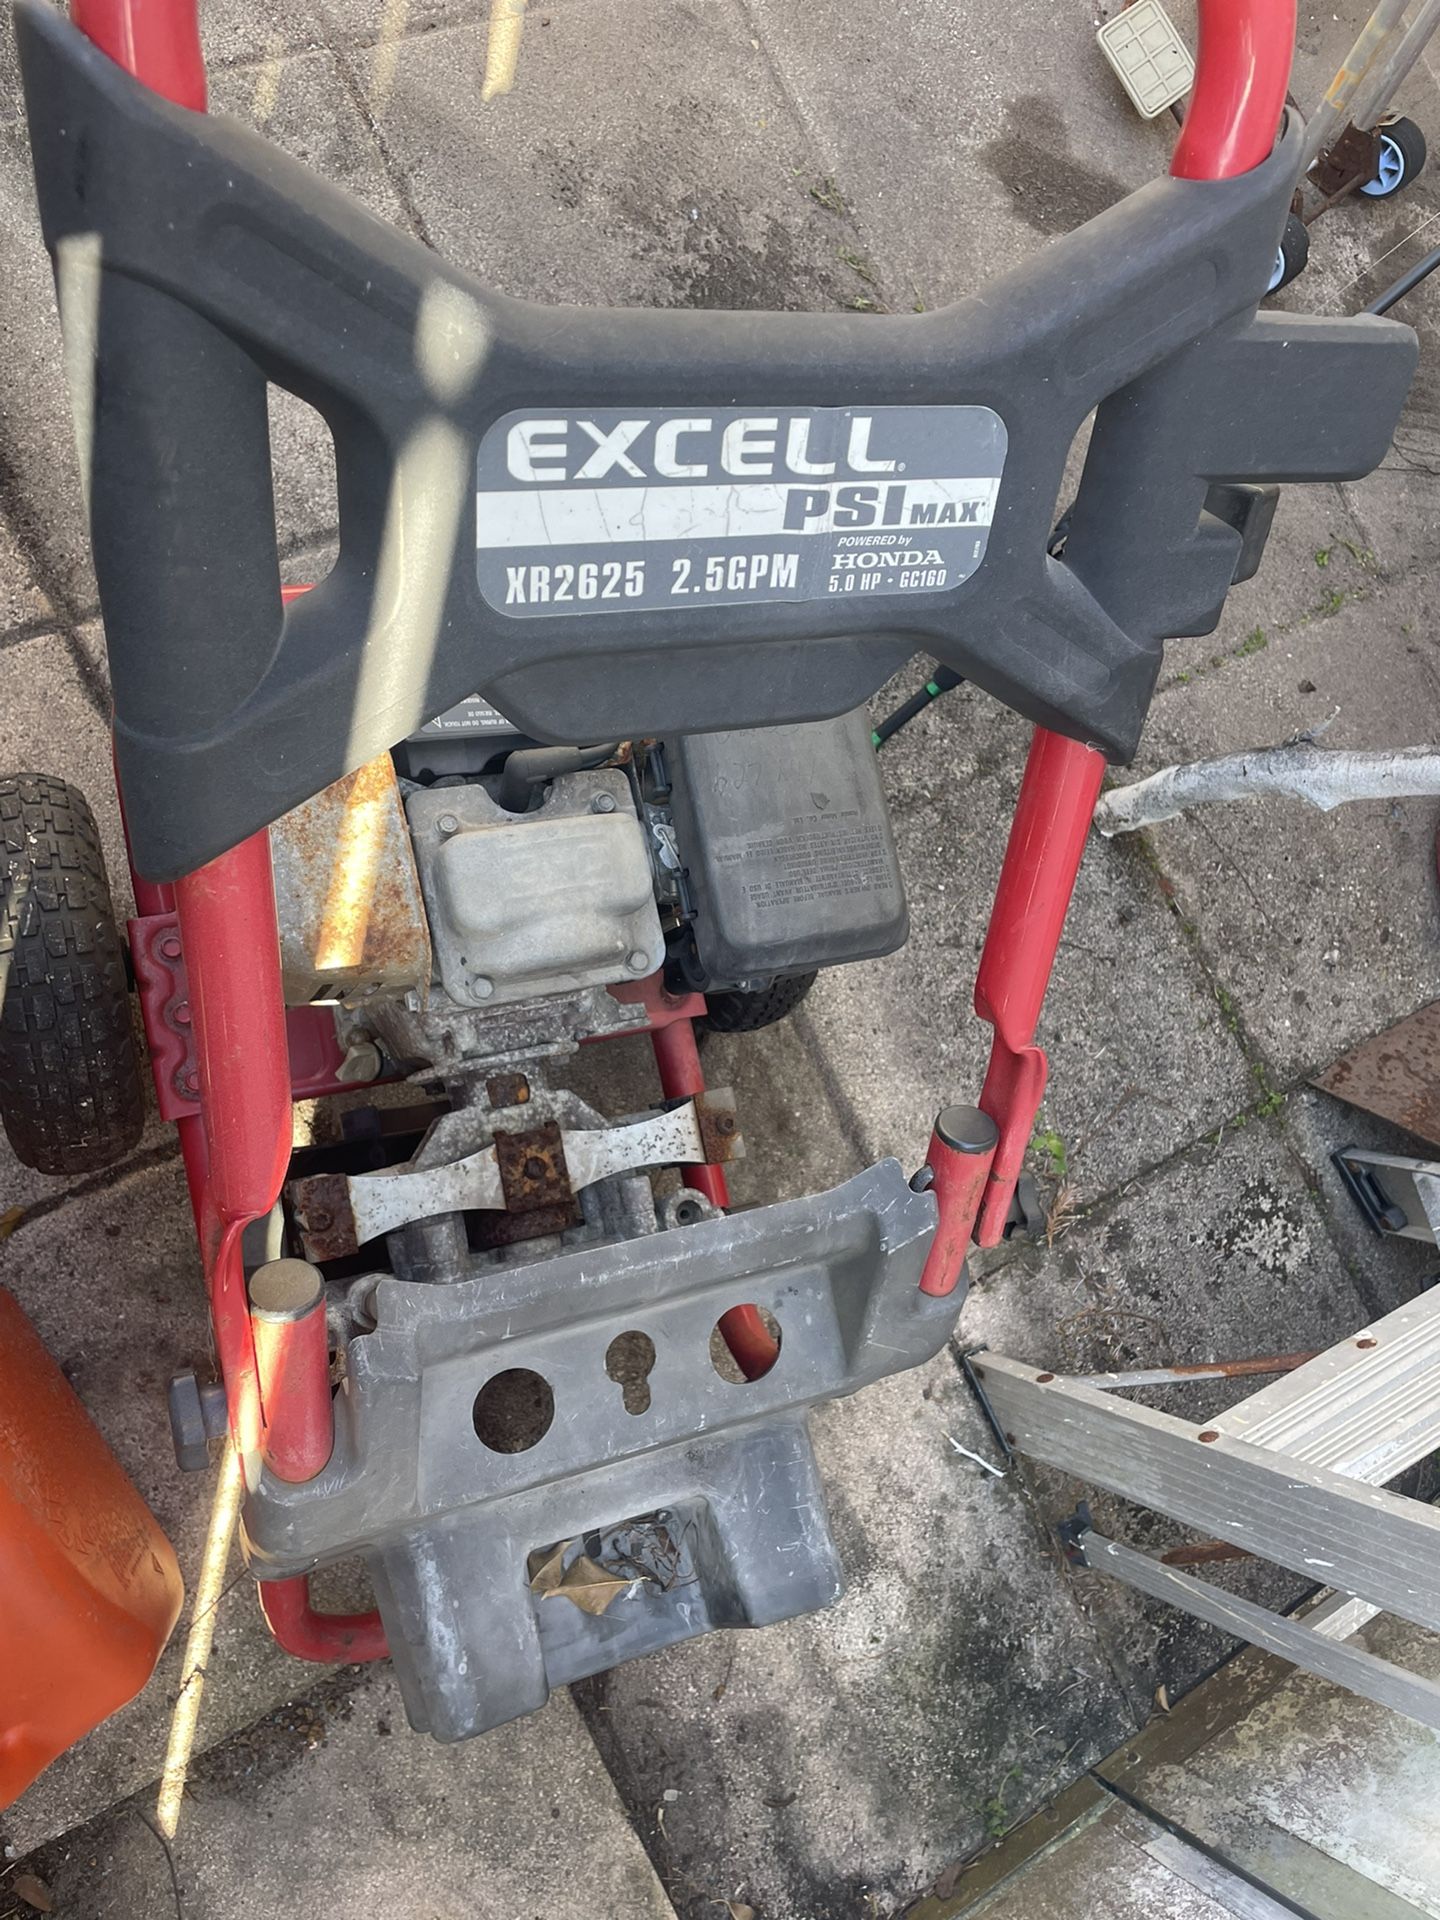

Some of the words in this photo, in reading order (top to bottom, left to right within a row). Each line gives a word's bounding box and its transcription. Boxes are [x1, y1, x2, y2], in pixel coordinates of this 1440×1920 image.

[507, 417, 896, 482] EXCELL
[783, 485, 907, 530] PSI
[909, 501, 980, 525] MAX
[837, 535, 896, 547] POWERED
[898, 535, 912, 547] by
[831, 550, 944, 570] HONDA
[505, 560, 646, 604] XR2625
[671, 553, 799, 594] 2.5GPM
[828, 575, 855, 592] 5.0
[860, 573, 881, 590] HP
[899, 570, 947, 588] GC160
